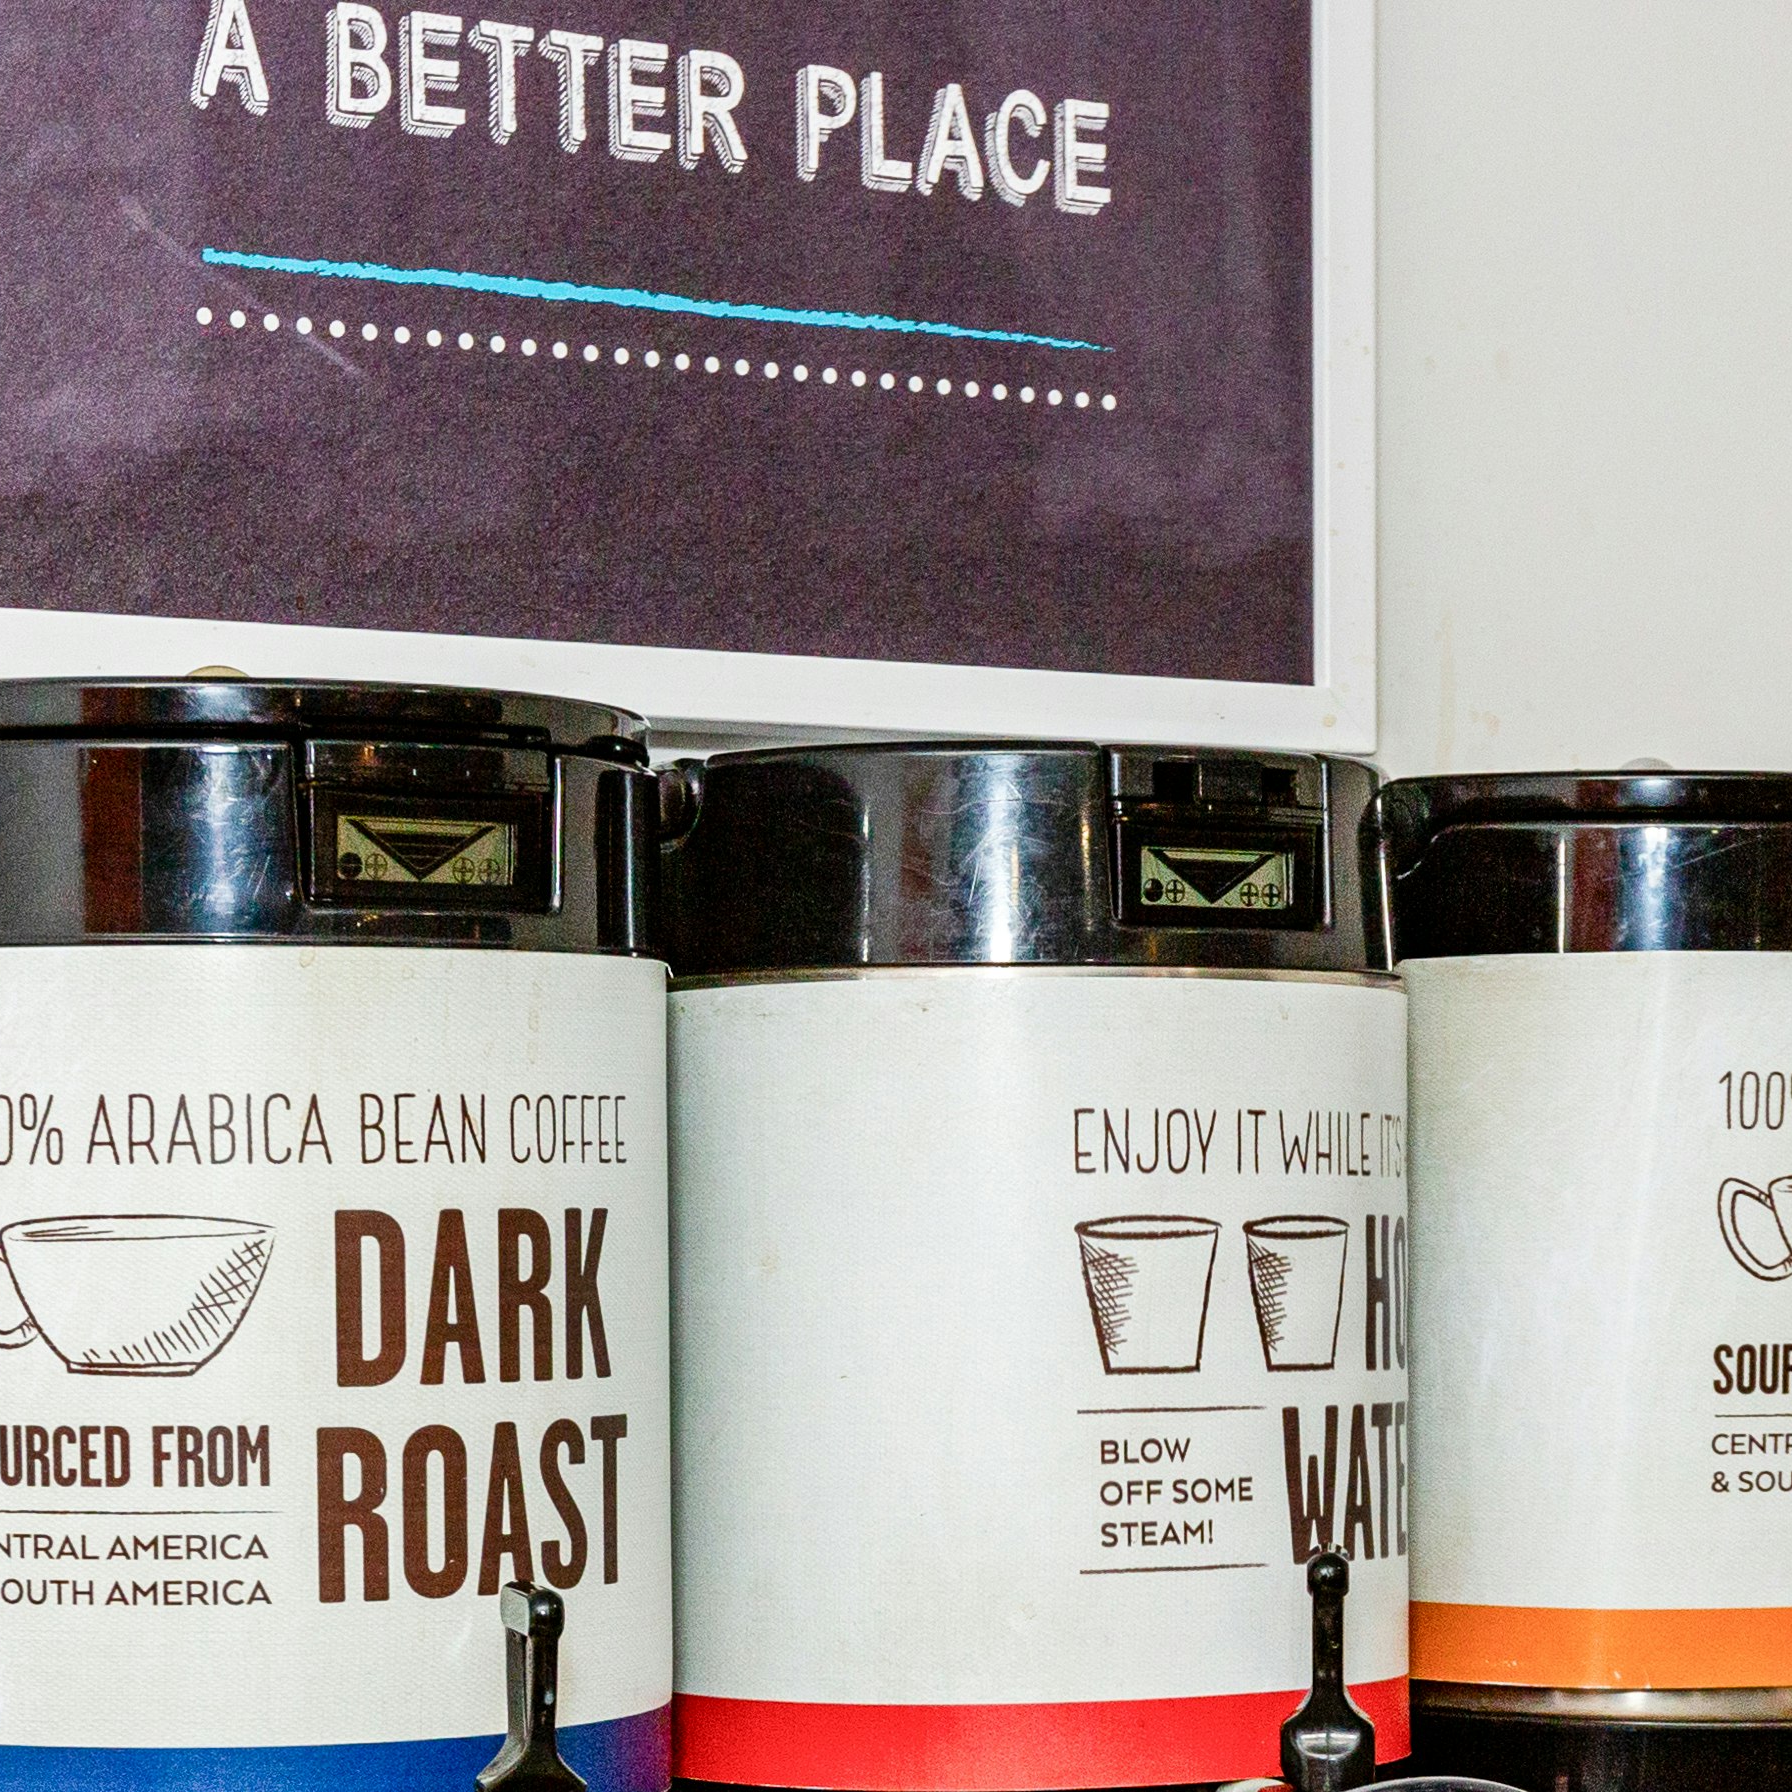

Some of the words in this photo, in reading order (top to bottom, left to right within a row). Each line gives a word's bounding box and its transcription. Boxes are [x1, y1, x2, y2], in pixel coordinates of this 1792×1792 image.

[190, 0, 271, 115] A
[325, 0, 747, 172] BETTER
[795, 64, 1113, 214] PLACE
[86, 1092, 334, 1166] ARABICA
[359, 1092, 488, 1166] BEAN
[509, 1093, 629, 1166] COFFEE
[1073, 1107, 1218, 1175] ENJOY
[1235, 1108, 1268, 1175] IT
[1278, 1109, 1371, 1178] WHILE
[333, 1207, 612, 1389] DARK
[151, 1424, 271, 1488] FROM
[1100, 1437, 1192, 1465] BLOW
[1099, 1478, 1164, 1507] OFF
[1172, 1476, 1254, 1504] SOME
[1710, 1469, 1730, 1494] &
[316, 1413, 629, 1604] ROAST
[105, 1532, 270, 1561] AMERICA
[1100, 1519, 1215, 1548] STEAM!
[104, 1577, 273, 1607] AMERICA
